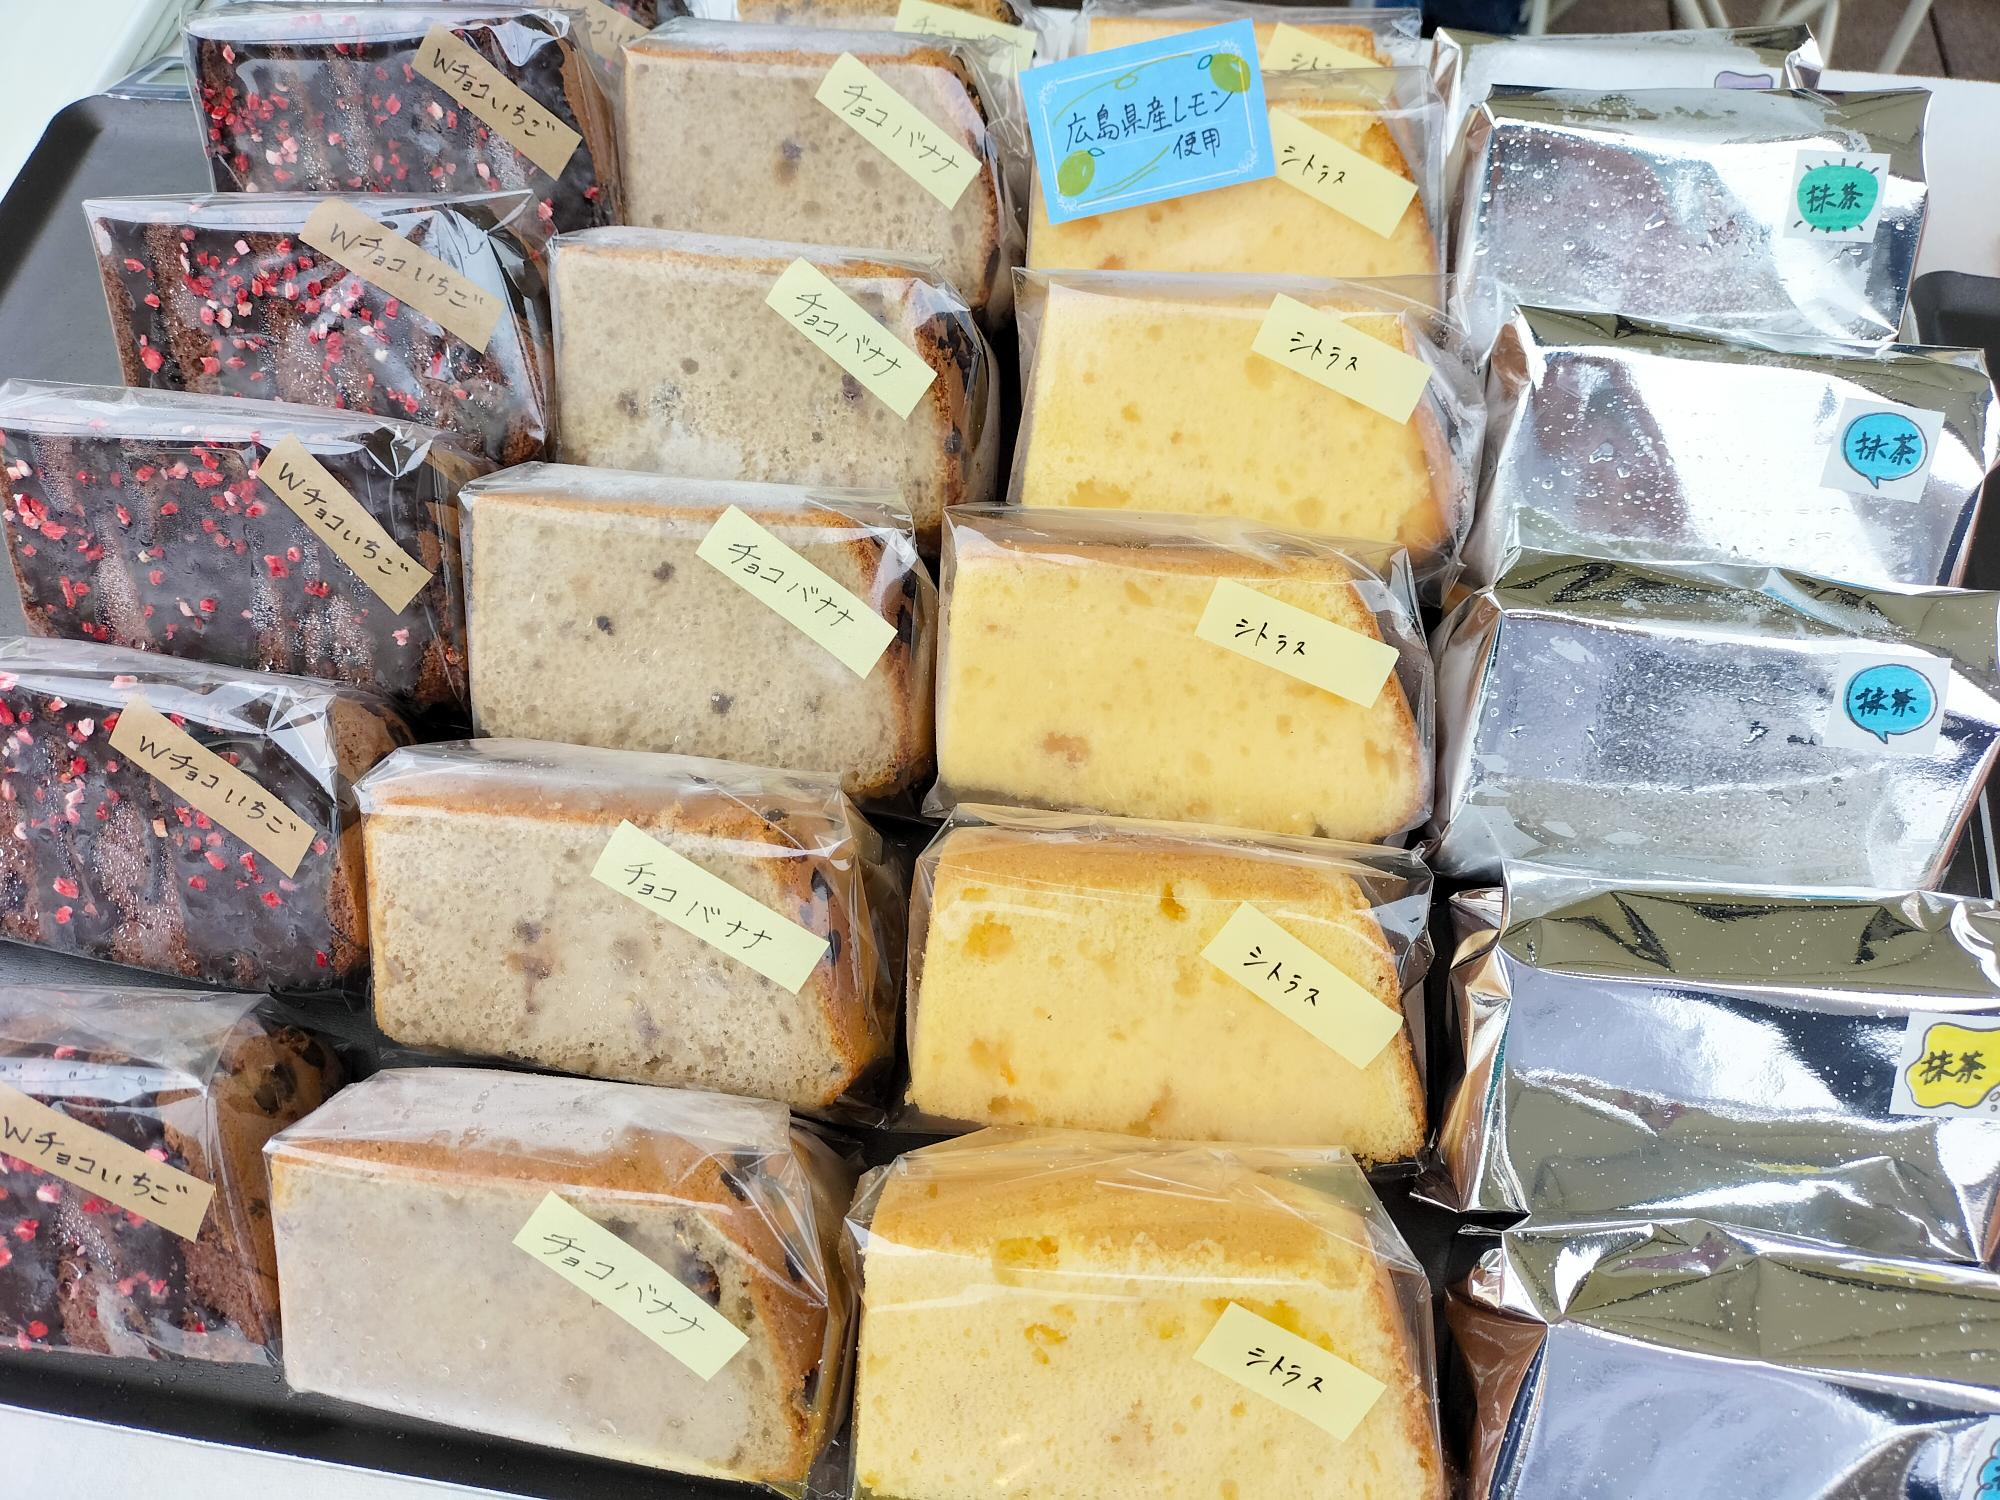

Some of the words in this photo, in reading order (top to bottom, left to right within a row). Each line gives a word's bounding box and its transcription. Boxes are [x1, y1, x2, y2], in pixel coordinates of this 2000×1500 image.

[433, 48, 556, 137] Wチョコいちご
[1066, 90, 1235, 152] 広島県産レモン
[842, 85, 960, 172] チョコバナナ
[1172, 128, 1221, 159] 使用
[1281, 146, 1346, 184] シトラス
[1806, 182, 1864, 213] 抹茶
[329, 223, 484, 309] Wチョコいちご
[794, 293, 902, 376] チョコバナナ
[1289, 331, 1358, 371] シトラス
[1855, 431, 1919, 466] 抹茶
[278, 462, 409, 575] Wチョコいちご
[728, 543, 855, 627] チョコバナナ
[1234, 618, 1306, 656] シトラス
[1855, 686, 1917, 718] 抹茶
[138, 735, 297, 834] Wチョコいちご
[624, 862, 773, 949] チョコバナナ
[1243, 946, 1320, 1007] シトラス
[1919, 1050, 1987, 1085] 抹茶
[4, 1116, 189, 1205] Wチョコいちご
[543, 1233, 705, 1334] チョコバナナ
[1246, 1348, 1324, 1393] シトラス
